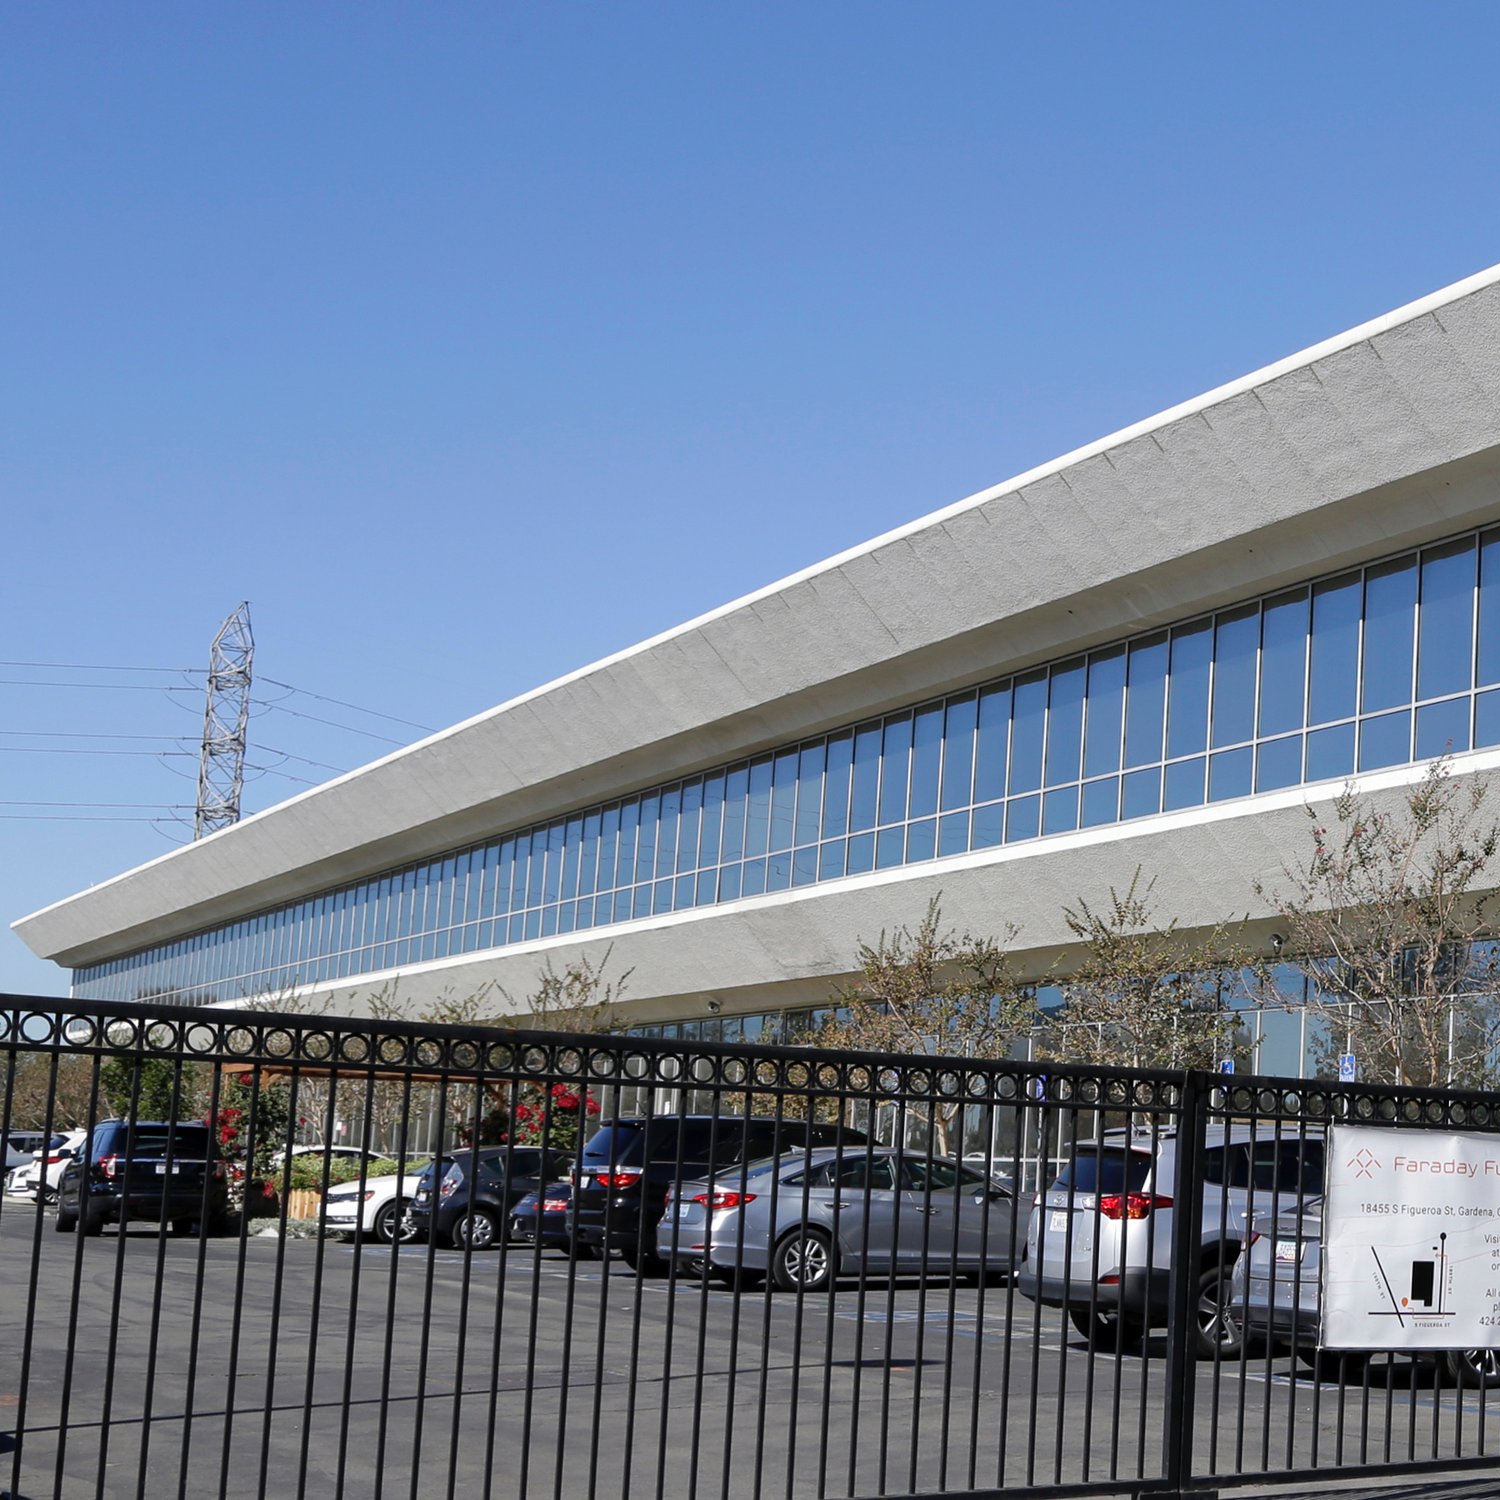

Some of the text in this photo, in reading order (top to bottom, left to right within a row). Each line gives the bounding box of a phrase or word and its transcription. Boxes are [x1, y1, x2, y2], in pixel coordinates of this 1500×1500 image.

[1394, 1156, 1478, 1178] Faraday
[1360, 1203, 1390, 1214] 18455
[1392, 1204, 1399, 1214] S
[1401, 1205, 1441, 1217] Figueroa
[1444, 1206, 1456, 1217] St,
[1458, 1207, 1495, 1218] Gardena,
[1491, 1248, 1500, 1257] at
[1485, 1288, 1496, 1298] All
